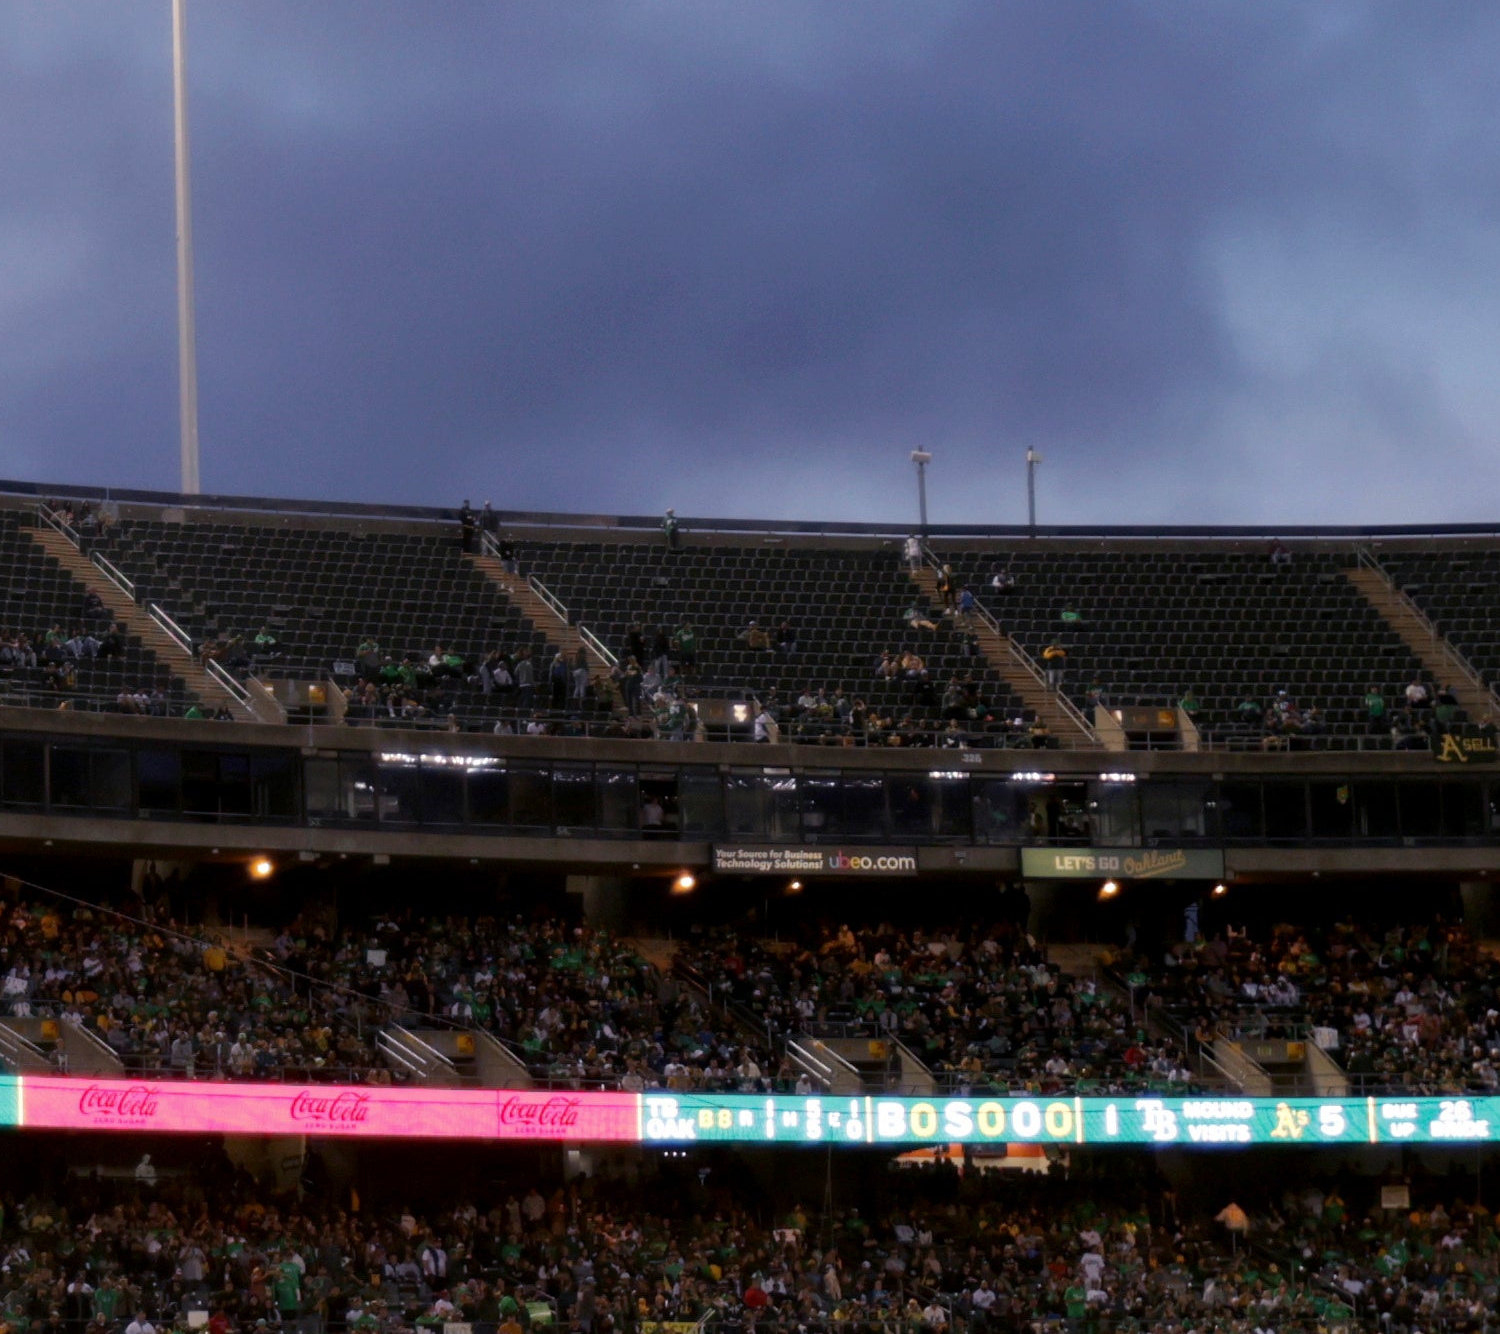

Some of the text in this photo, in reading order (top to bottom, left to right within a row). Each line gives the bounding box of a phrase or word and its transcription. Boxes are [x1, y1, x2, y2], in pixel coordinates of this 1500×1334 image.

[716, 851, 915, 872] Technology Solutions! ubeo.com
[737, 850, 768, 859] Source
[784, 851, 822, 861] Business
[1055, 849, 1187, 878] LET'S GO Oakland
[646, 1098, 858, 1118] TB 1 5 1
[1183, 1102, 1254, 1120] MOUND
[1319, 1105, 1344, 1137] 5
[1382, 1102, 1418, 1120] DUE
[1439, 1100, 1472, 1122] 26
[646, 1119, 863, 1140] OAK 1 5 0
[699, 1109, 733, 1129] B8
[1189, 1123, 1250, 1143] VISITS
[1391, 1122, 1414, 1139] UP
[1431, 1119, 1490, 1139] BRIDE
